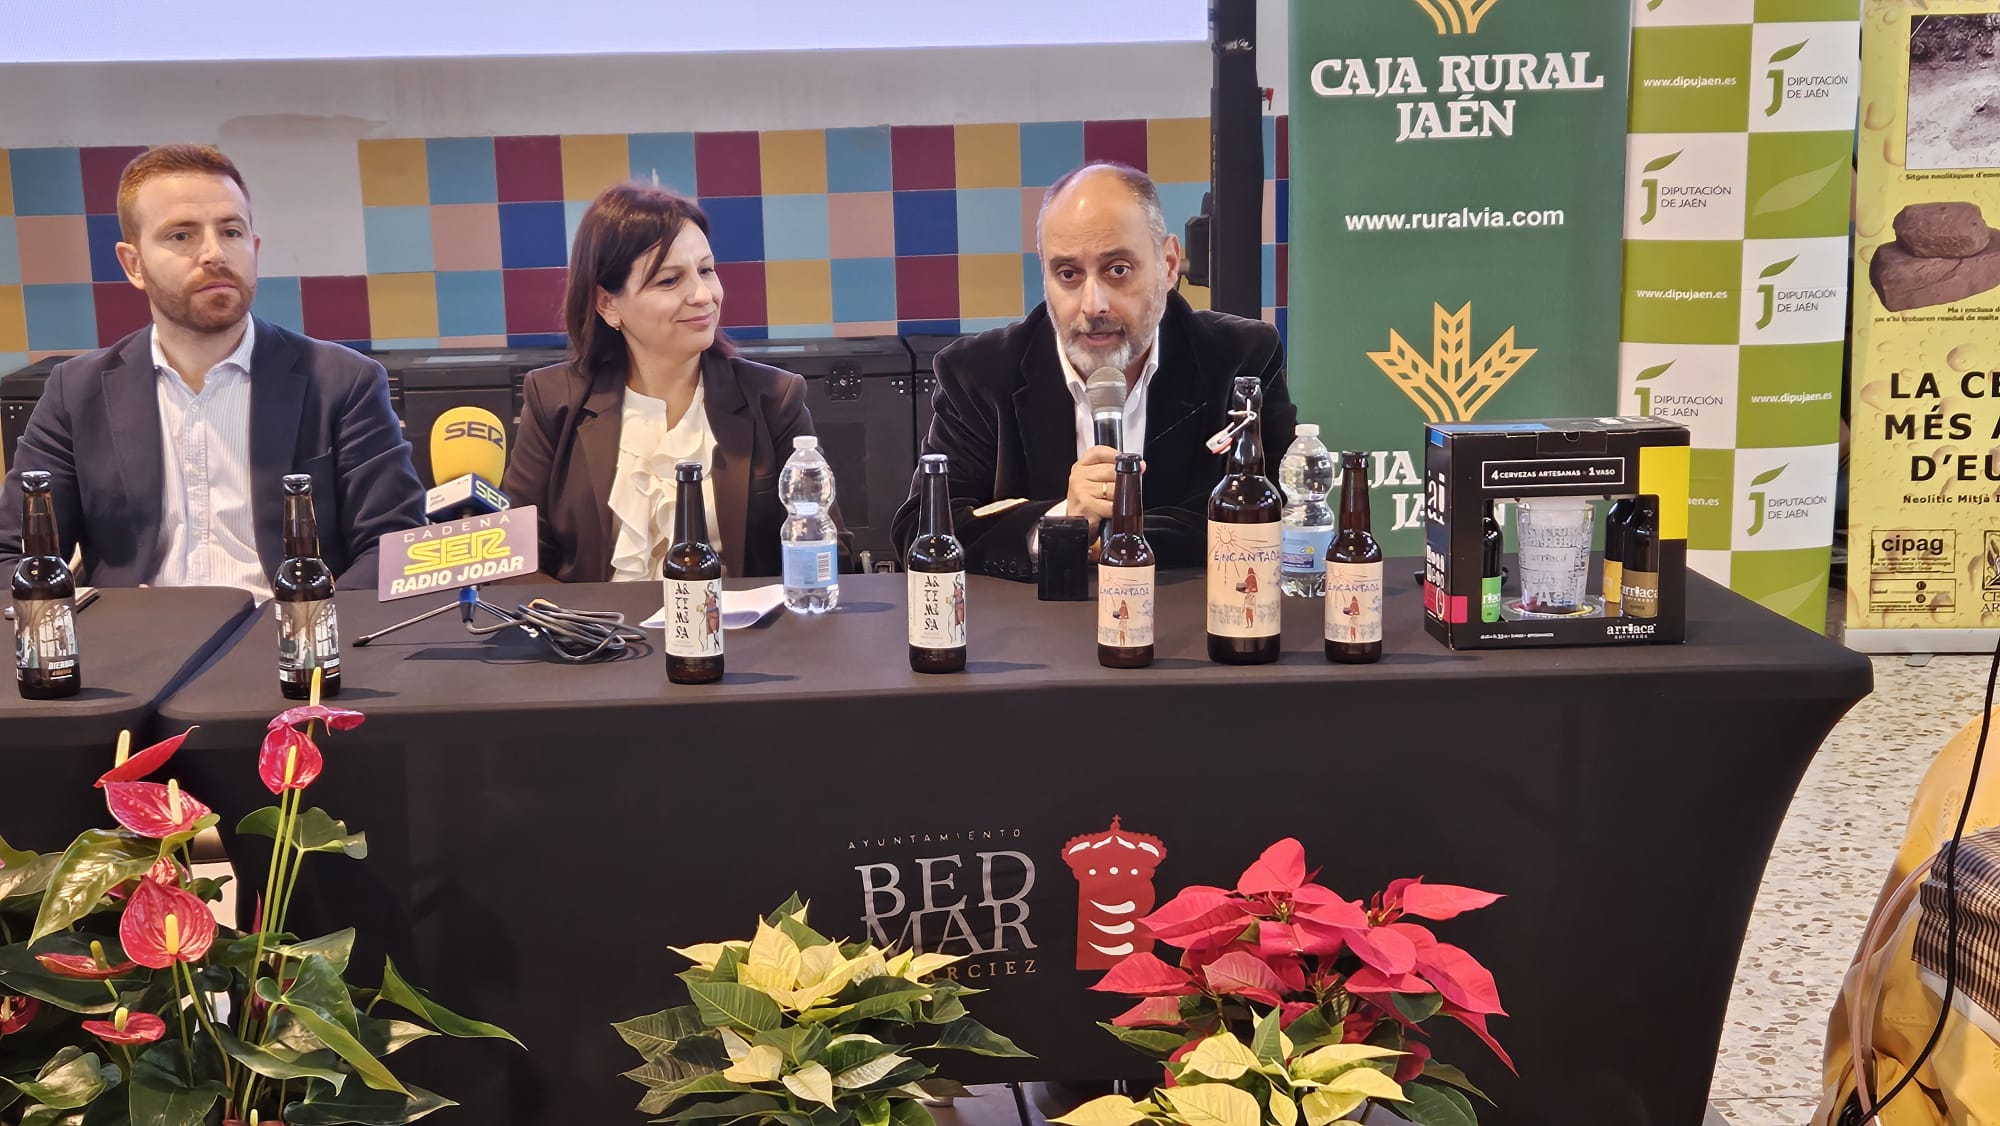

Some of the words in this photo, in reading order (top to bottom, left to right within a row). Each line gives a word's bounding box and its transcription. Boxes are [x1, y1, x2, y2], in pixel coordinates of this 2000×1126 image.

[1310, 57, 1427, 98] CAJA
[1438, 51, 1604, 93] RURAL
[1787, 75, 1848, 87] DIPUTACIÓN
[1643, 75, 1737, 88] www.dipujaen.es
[1786, 89, 1801, 98] DE
[1803, 87, 1830, 98] JAÉN
[1395, 94, 1516, 142] JAÉN
[1661, 185, 1732, 196] DIPUTACIÓN
[1660, 199, 1677, 208] DE
[1678, 197, 1707, 208] JAÉN
[1345, 207, 1564, 231] www.ruralvia.com
[1636, 289, 1728, 300] www.dipujaen.es
[1777, 288, 1837, 300] DIPUTACIÓN
[1777, 302, 1792, 312] DE
[1792, 300, 1819, 312] JAÉN
[1890, 372, 1941, 399] LA
[1654, 395, 1723, 405] DIPUTACIÓN
[1751, 391, 1832, 404] www.dipujaen.es
[1654, 407, 1669, 416] DE
[1670, 406, 1699, 417] JAÉN
[1884, 404, 1972, 441] MÉS
[444, 420, 503, 450] SER
[1491, 470, 1499, 480] 4
[1500, 470, 1536, 478] CERVEZAS
[1538, 469, 1581, 477] ARTESANAS
[1588, 467, 1595, 476] 1
[1596, 468, 1616, 476] VASO
[474, 480, 511, 512] SER
[1768, 495, 1827, 508] DIPUTACIÓN
[1768, 509, 1782, 519] DE
[1783, 507, 1809, 519] JAÉN
[403, 514, 511, 543] CADENA
[403, 528, 511, 575] SER
[1881, 534, 1944, 556] cipag
[1214, 551, 1281, 563] ENCANTADA
[390, 569, 452, 594] RADIO
[457, 556, 525, 582] JODAR
[1328, 583, 1380, 592] ENCANTADA
[1606, 623, 1655, 635] arriaca
[848, 828, 1021, 850] AYUNTAMIENTO
[854, 850, 1036, 920] BED
[860, 900, 1038, 958] MAR
